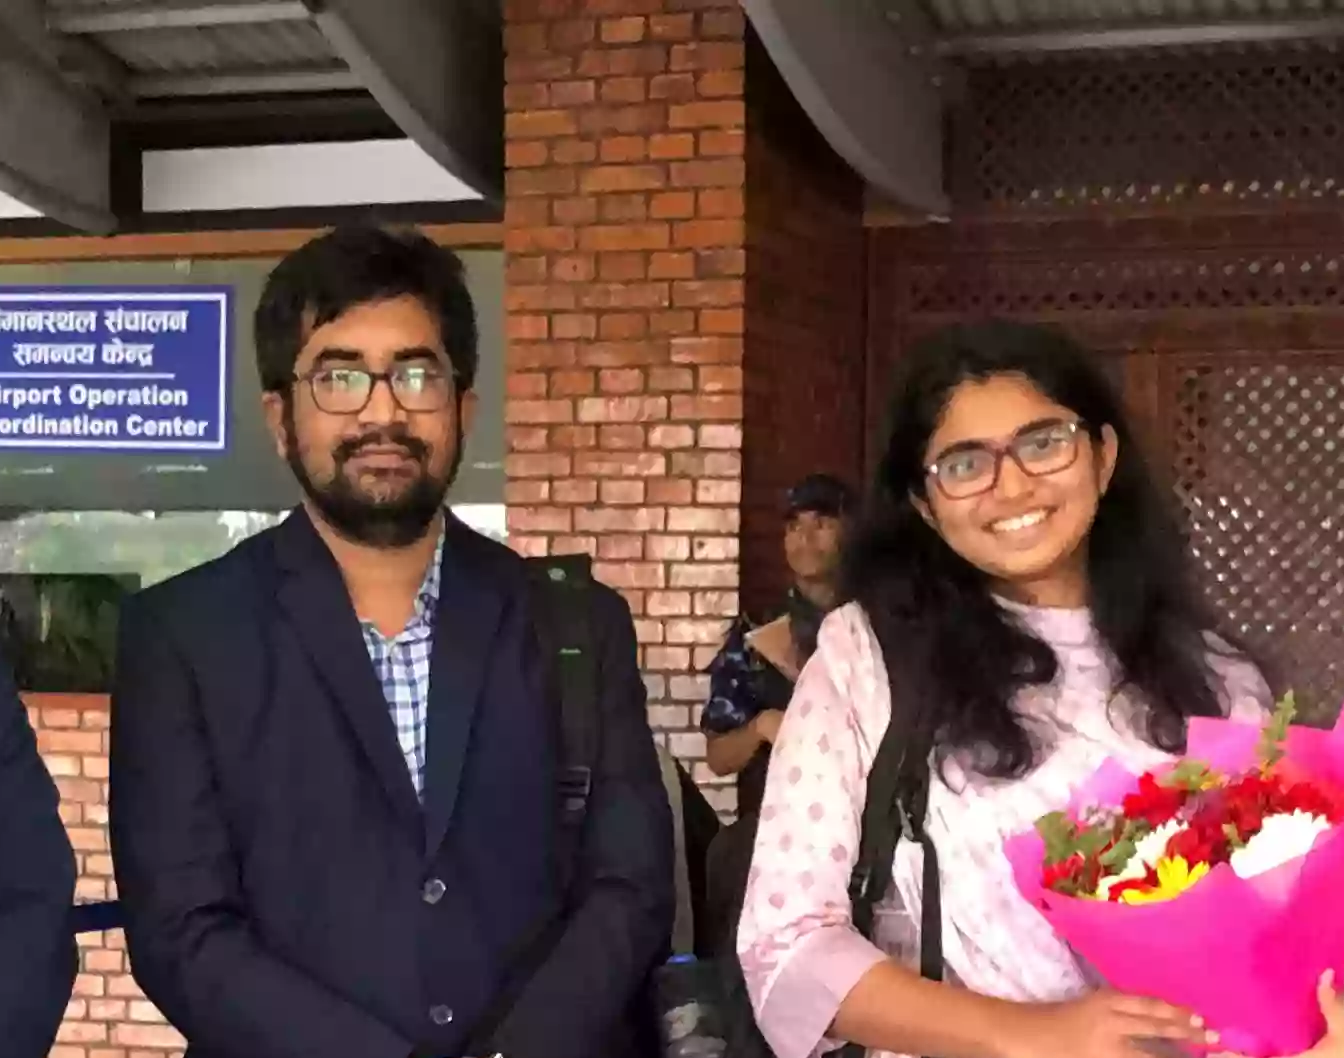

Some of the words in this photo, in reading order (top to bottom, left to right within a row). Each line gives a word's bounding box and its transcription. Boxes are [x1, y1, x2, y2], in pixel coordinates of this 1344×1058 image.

[103, 306, 190, 333] संचालन
[12, 342, 97, 367] समन्वय
[101, 337, 155, 368] केन्द्र
[69, 383, 189, 410] Operation
[126, 413, 209, 437] Center
